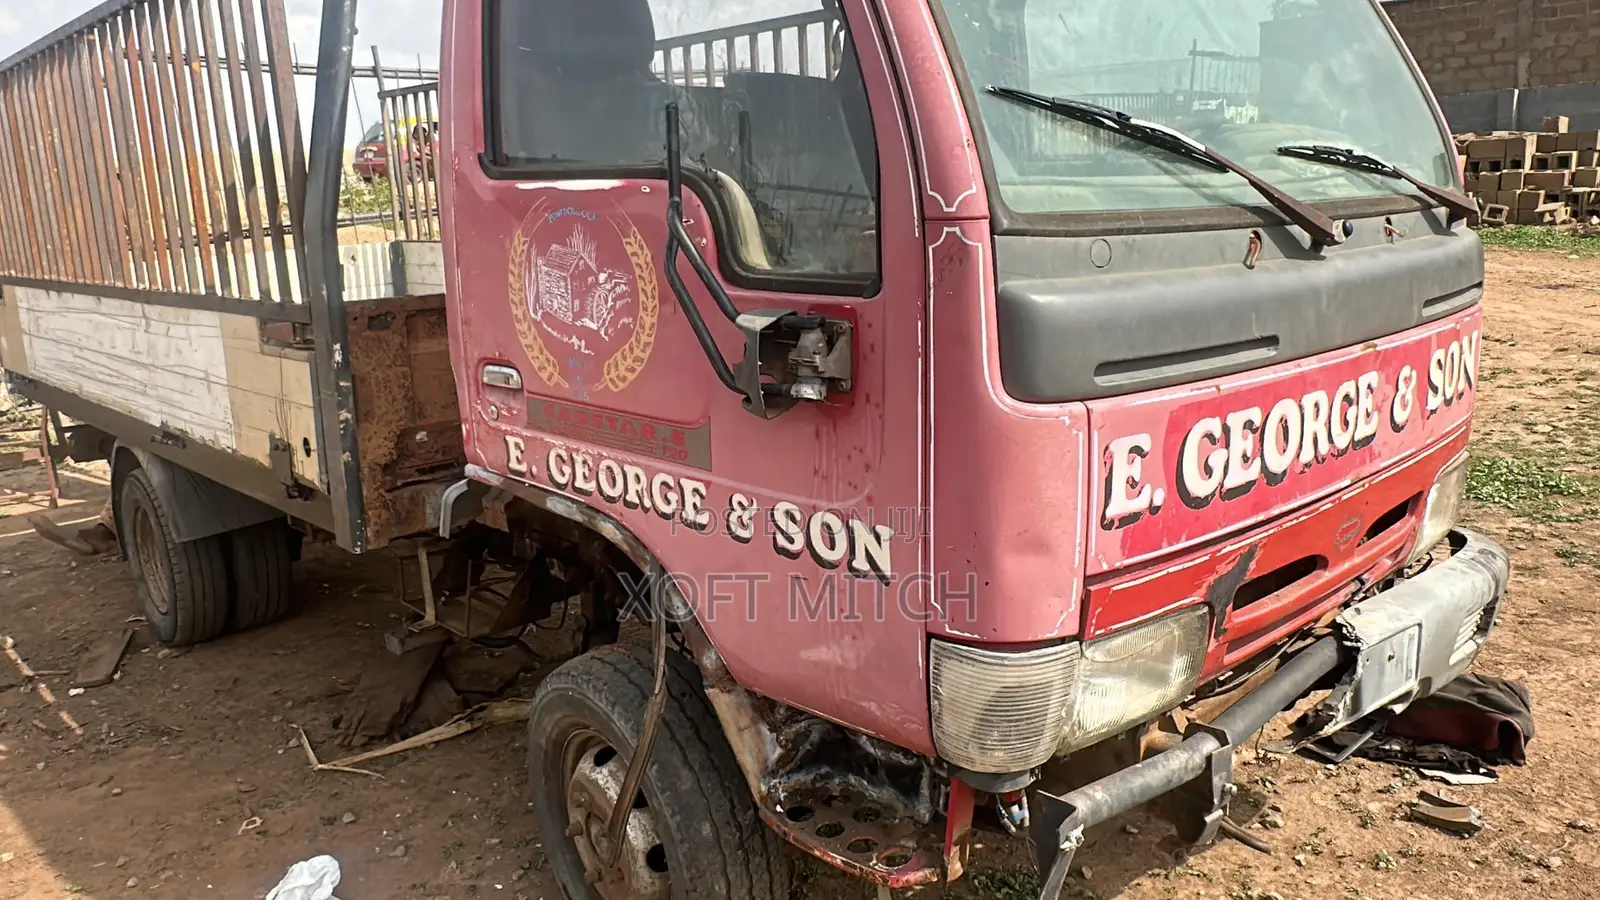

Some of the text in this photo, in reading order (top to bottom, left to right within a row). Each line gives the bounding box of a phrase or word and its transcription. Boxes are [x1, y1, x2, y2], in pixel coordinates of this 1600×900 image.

[504, 435, 894, 587] E. GEORGE & SON
[1100, 330, 1479, 530] E. GEORGE & SON
